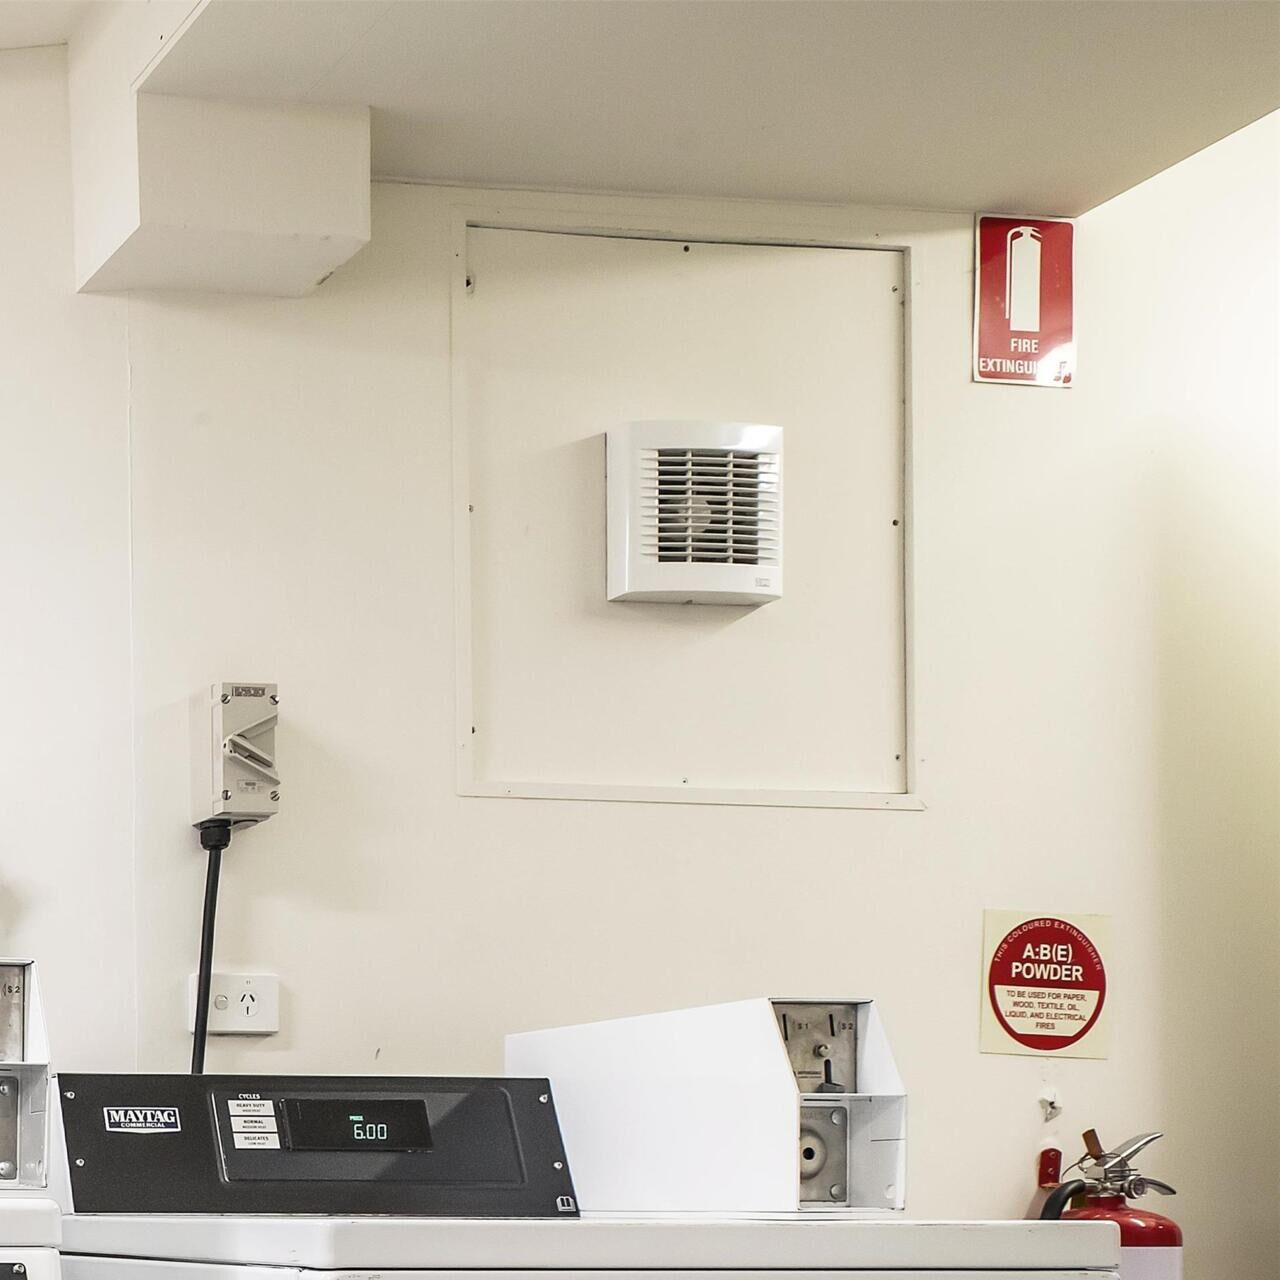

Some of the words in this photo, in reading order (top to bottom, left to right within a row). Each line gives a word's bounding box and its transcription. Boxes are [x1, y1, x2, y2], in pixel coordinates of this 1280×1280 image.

[1010, 338, 1039, 353] FIRE
[980, 357, 1040, 375] EXTINGUI
[995, 942, 1008, 962] THIS
[1007, 920, 1051, 942] COLOURED
[1011, 962, 1083, 981] POWDER
[1046, 1013, 1087, 1021] ELECTRICAL
[1035, 1022, 1055, 1030] FIRES
[109, 1110, 175, 1123] MAYTAG
[354, 1124, 387, 1139] 6.00
